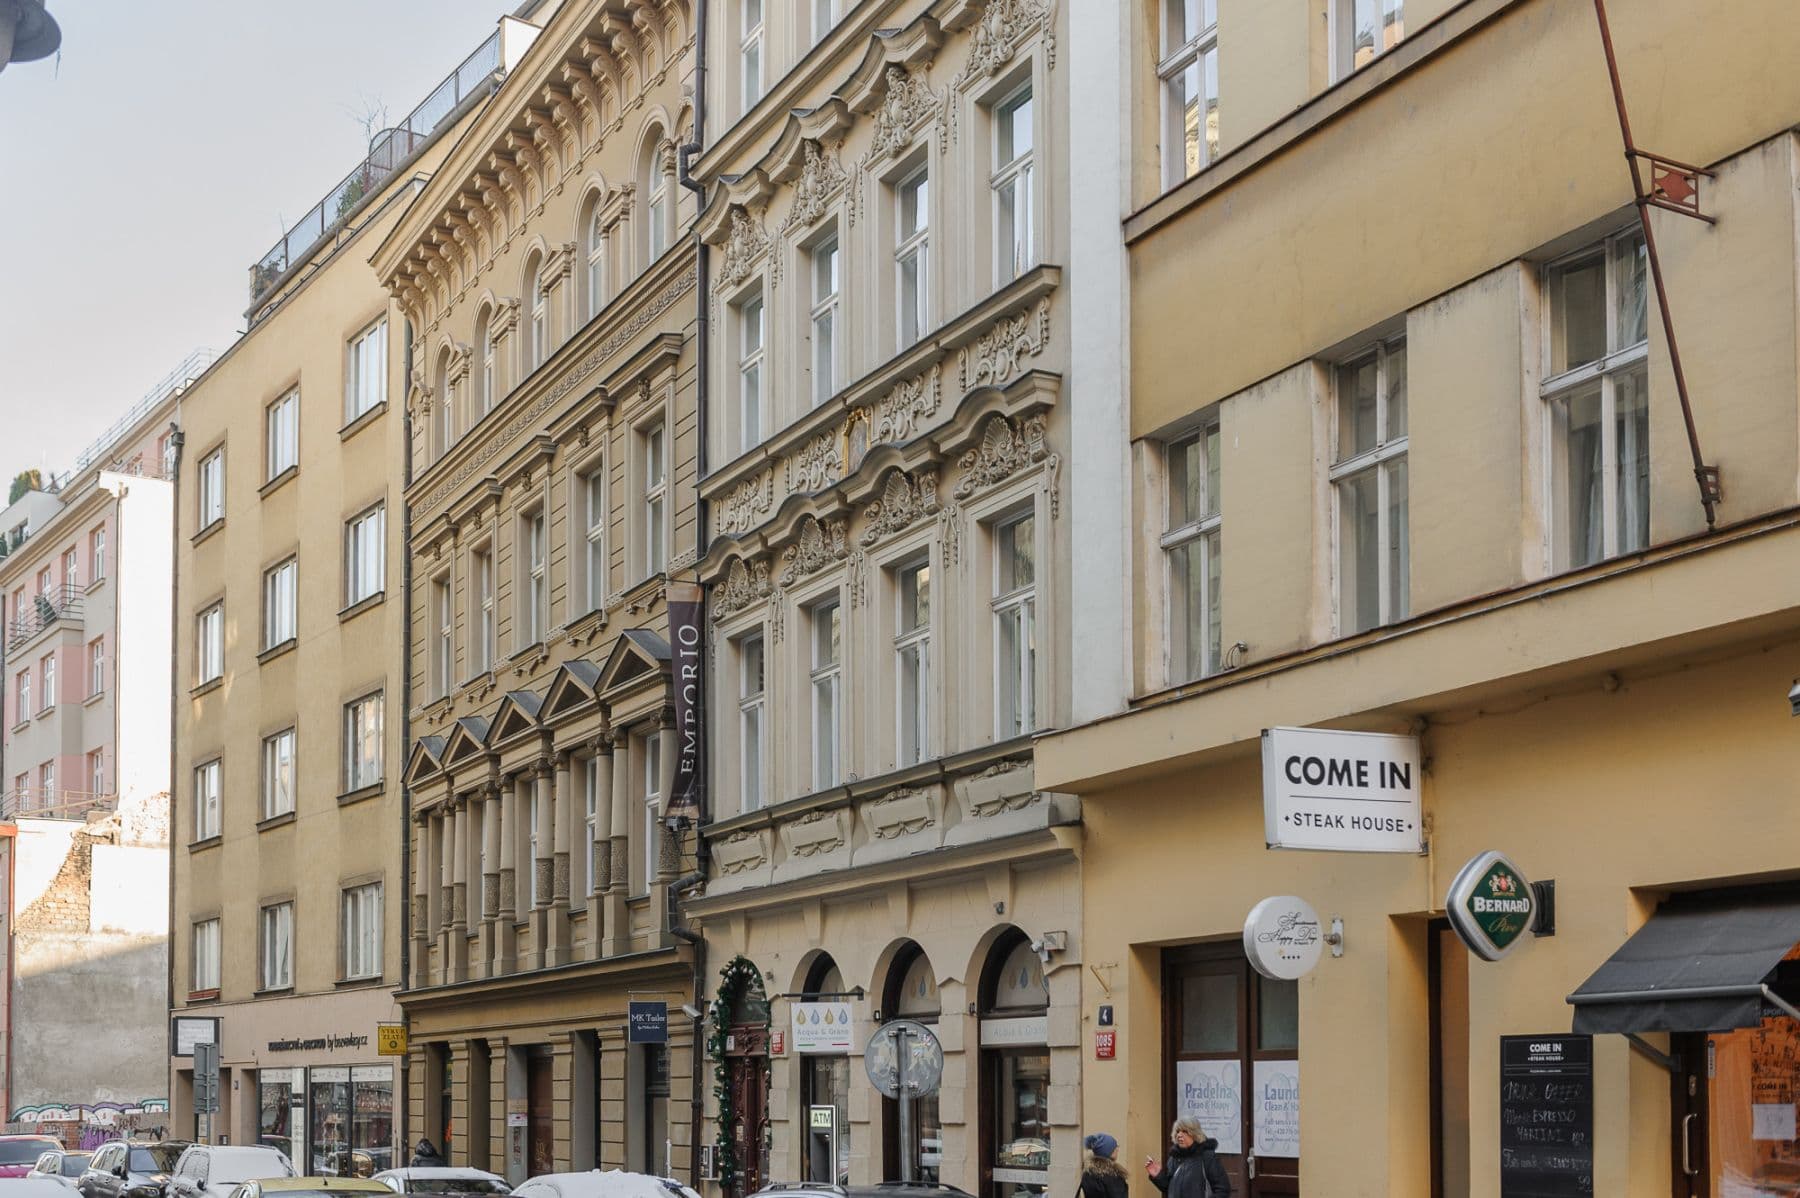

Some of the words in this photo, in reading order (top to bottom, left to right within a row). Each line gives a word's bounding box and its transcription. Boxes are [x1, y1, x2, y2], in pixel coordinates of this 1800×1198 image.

[678, 624, 699, 774] EMPORIO
[1285, 755, 1369, 788] COME
[1380, 761, 1411, 790] IN
[1293, 812, 1345, 829] STEAK
[1351, 816, 1404, 833] HOUSE
[1473, 896, 1530, 913] BERNARD
[631, 1013, 645, 1022] MK
[1102, 1008, 1108, 1023] 4
[1530, 1043, 1551, 1053] COME
[1552, 1043, 1562, 1052] IN
[1187, 1100, 1204, 1110] Clean
[1264, 1102, 1282, 1112] Clean
[814, 1112, 831, 1124] ATM
[1533, 1110, 1576, 1122] ESPRESSO
